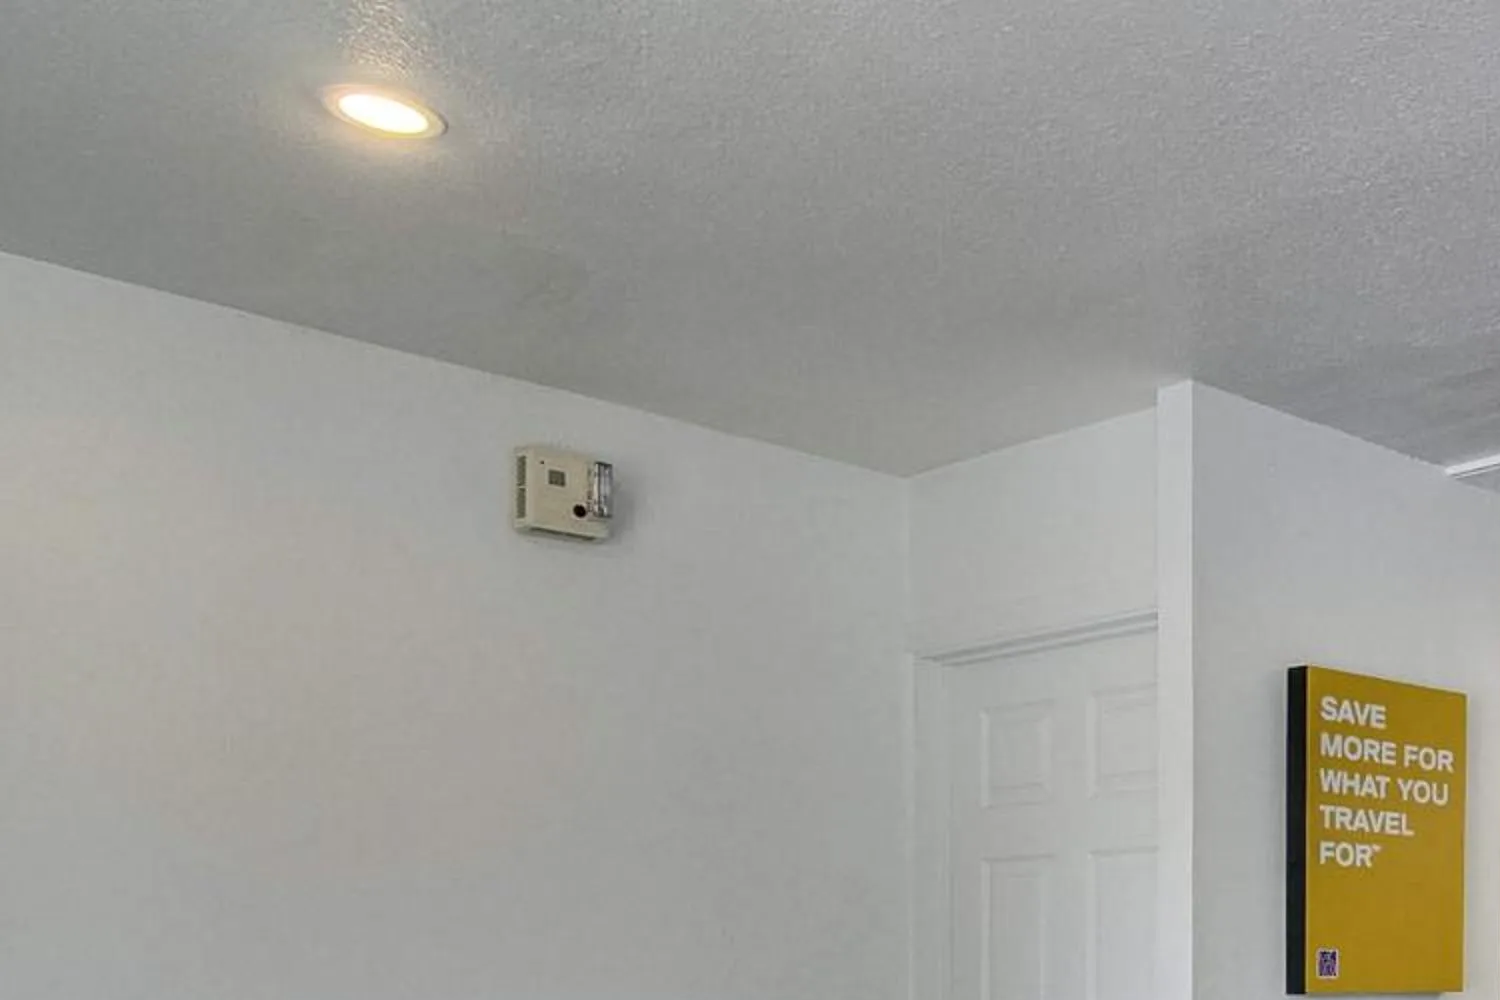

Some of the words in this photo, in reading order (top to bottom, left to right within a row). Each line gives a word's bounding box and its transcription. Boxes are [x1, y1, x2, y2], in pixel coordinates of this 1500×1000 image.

[1320, 696, 1386, 729] SAVE
[1320, 733, 1396, 765] MORE
[1403, 745, 1454, 773] FOR
[1319, 768, 1391, 799] WHAT
[1397, 777, 1448, 806] YOU
[1319, 804, 1414, 836] TRAVEL
